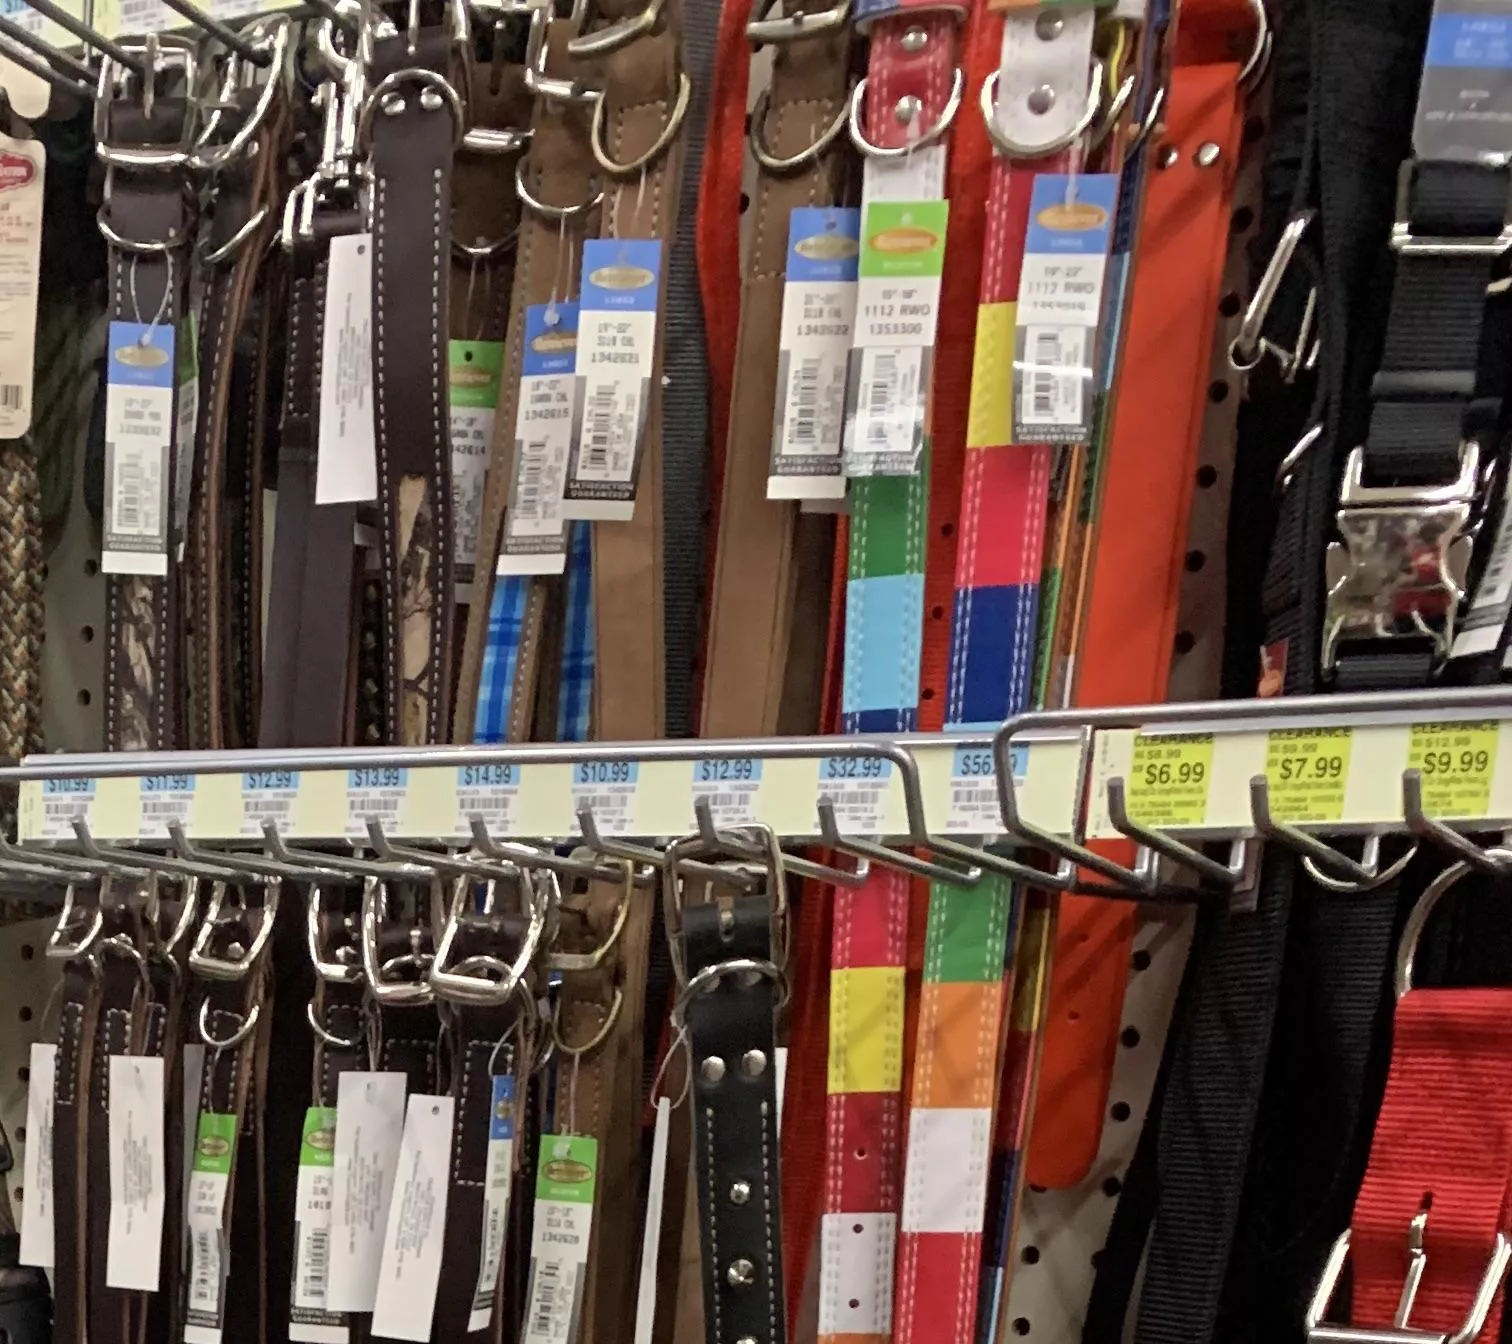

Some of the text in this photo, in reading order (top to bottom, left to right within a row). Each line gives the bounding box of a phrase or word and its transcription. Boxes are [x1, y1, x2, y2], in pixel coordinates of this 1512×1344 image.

[1028, 281, 1095, 295] 1112 RWO
[864, 303, 931, 317] 1112 RWO
[869, 323, 923, 336] 1353300
[580, 761, 630, 783] $10.99
[701, 759, 753, 781] $12.99
[828, 757, 882, 779] $32.99
[1279, 756, 1343, 781] $7.99
[1423, 750, 1490, 776] $9.99
[146, 775, 189, 791] $11.99
[248, 771, 290, 788] $12.99
[354, 769, 400, 787] $13.99
[465, 765, 511, 785] $14.99
[1144, 761, 1206, 786] $6.99
